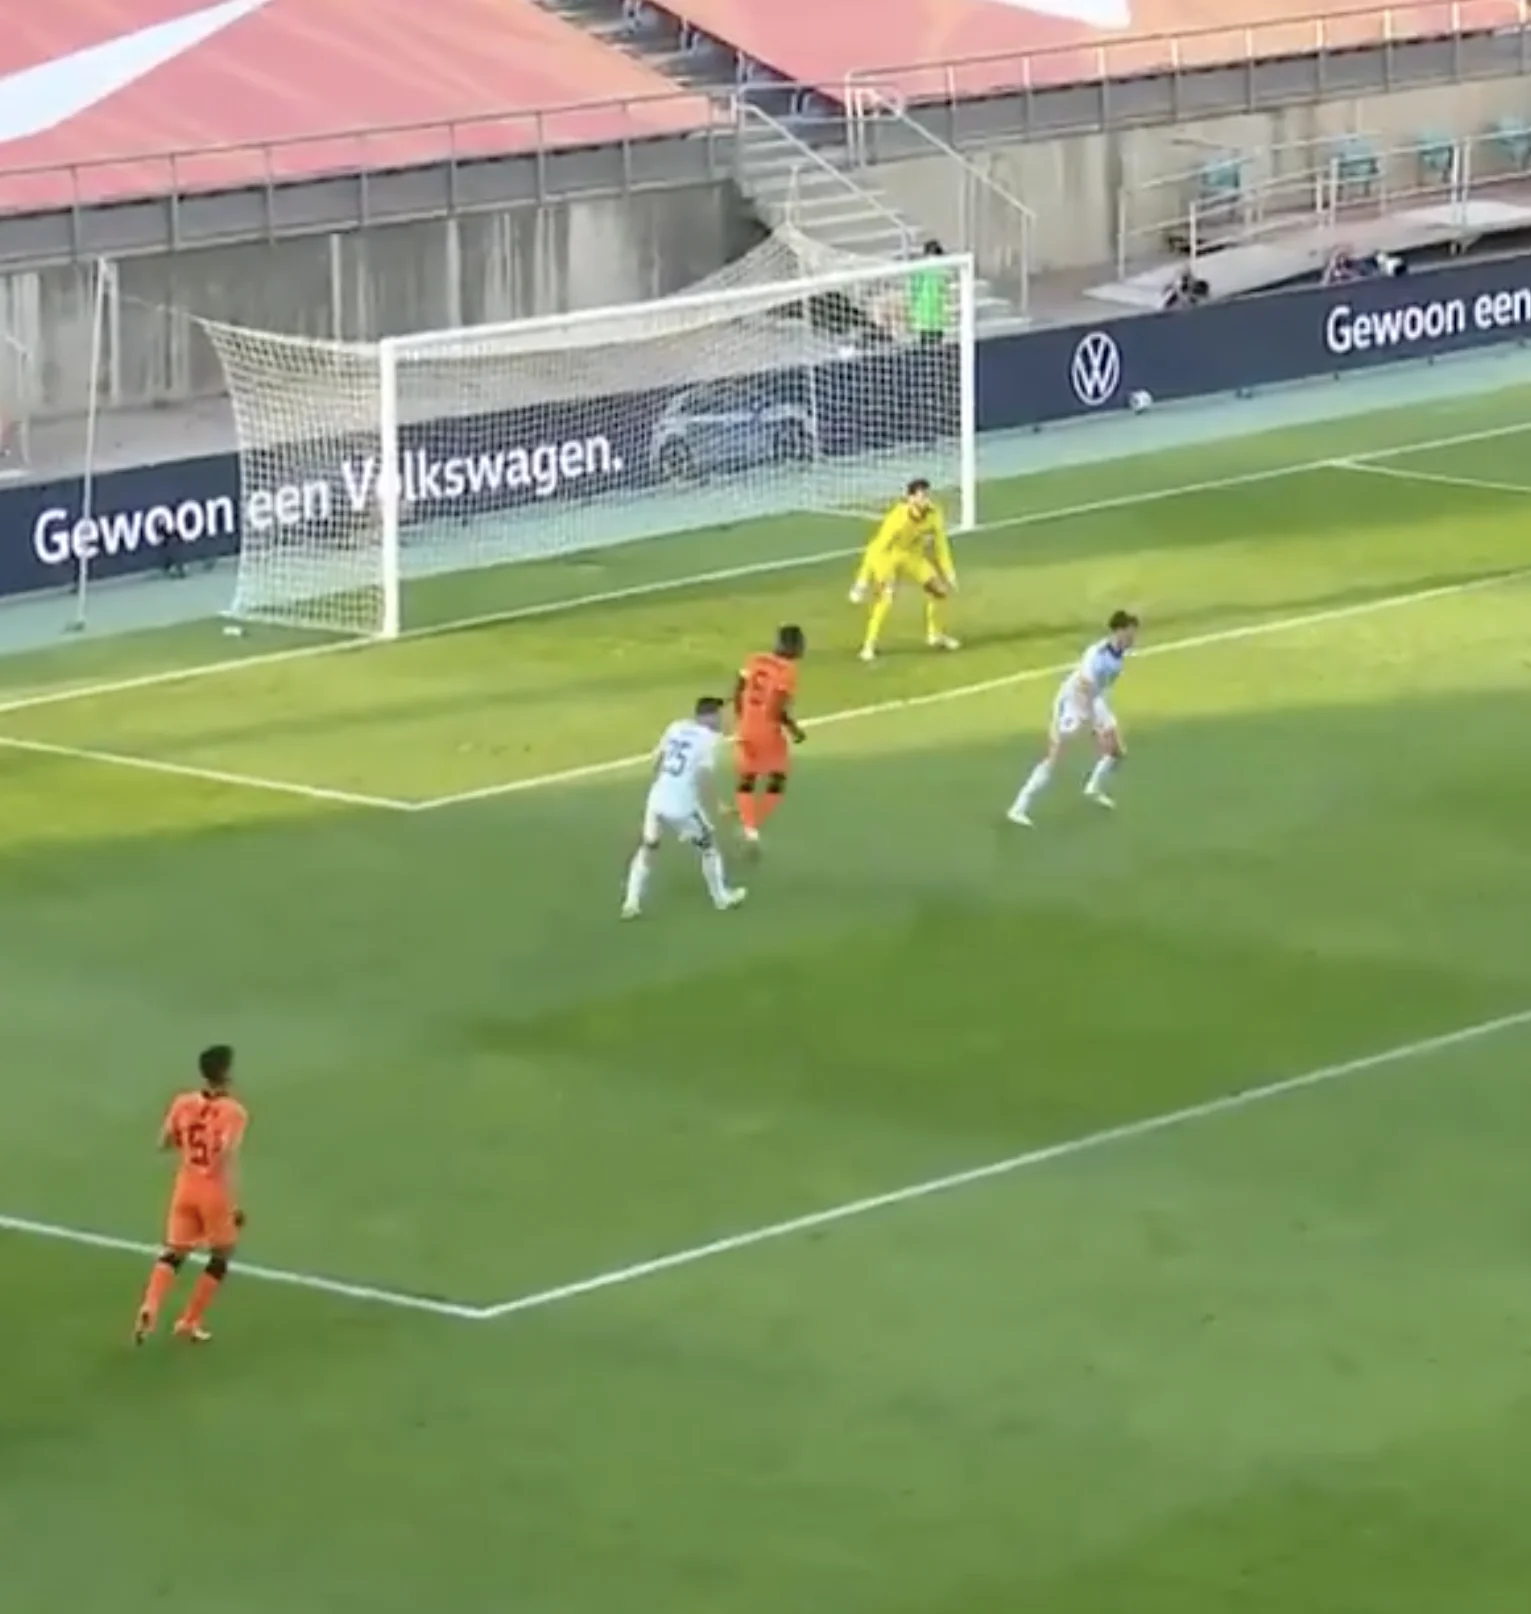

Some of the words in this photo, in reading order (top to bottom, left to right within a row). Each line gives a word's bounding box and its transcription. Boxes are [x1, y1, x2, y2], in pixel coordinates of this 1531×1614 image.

[1326, 298, 1466, 353] Gewoon
[1473, 286, 1531, 328] een
[34, 496, 234, 564] Gewoon
[249, 479, 329, 530] een
